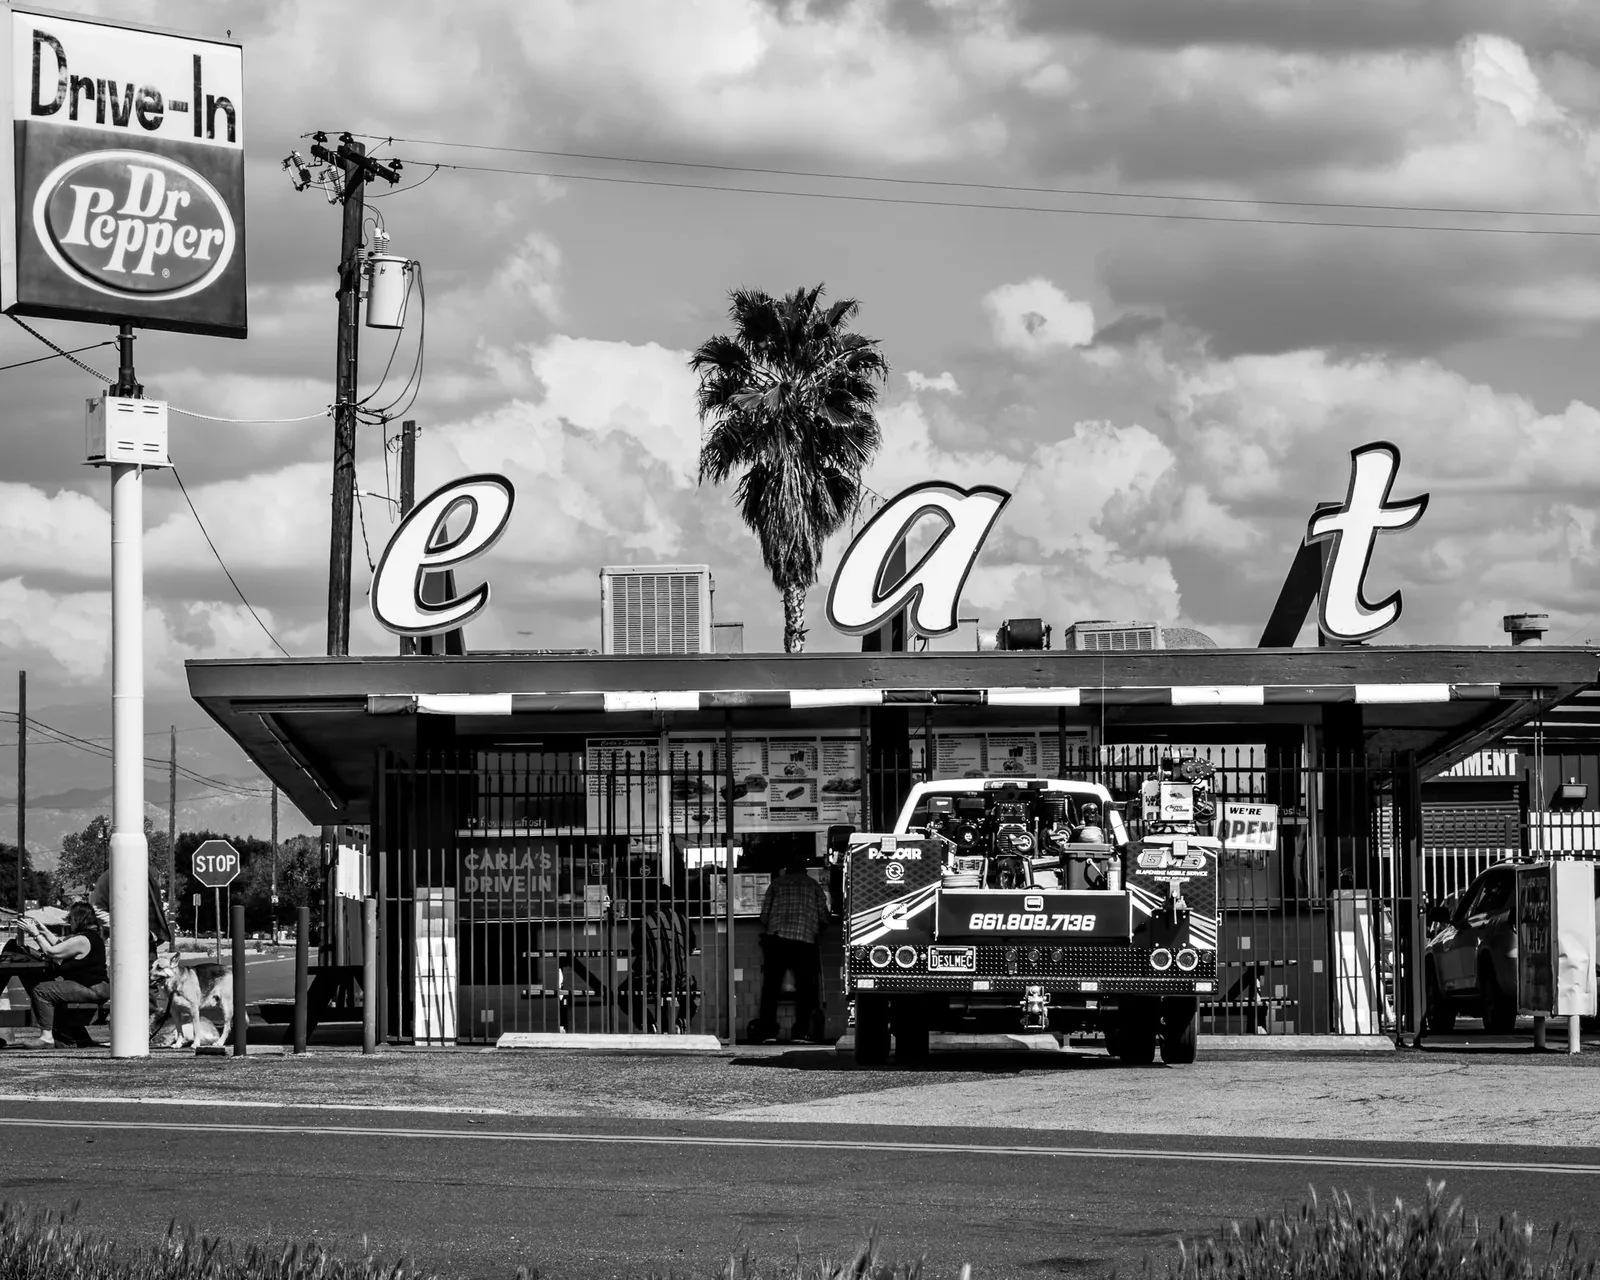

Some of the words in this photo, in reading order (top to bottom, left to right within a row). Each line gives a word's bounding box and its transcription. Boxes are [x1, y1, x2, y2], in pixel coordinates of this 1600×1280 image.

[31, 29, 236, 143] Drive-In
[117, 164, 191, 222] Dr
[59, 184, 224, 276] Pepper
[1229, 806, 1262, 815] WE'RE
[1217, 819, 1274, 844] OPEN
[196, 855, 236, 873] STOP
[464, 852, 552, 870] CARLA'S
[464, 875, 526, 893] DRIVE
[531, 875, 552, 892] IN
[969, 913, 1096, 931] 661.809.7136
[931, 955, 972, 967] DESLMEC
